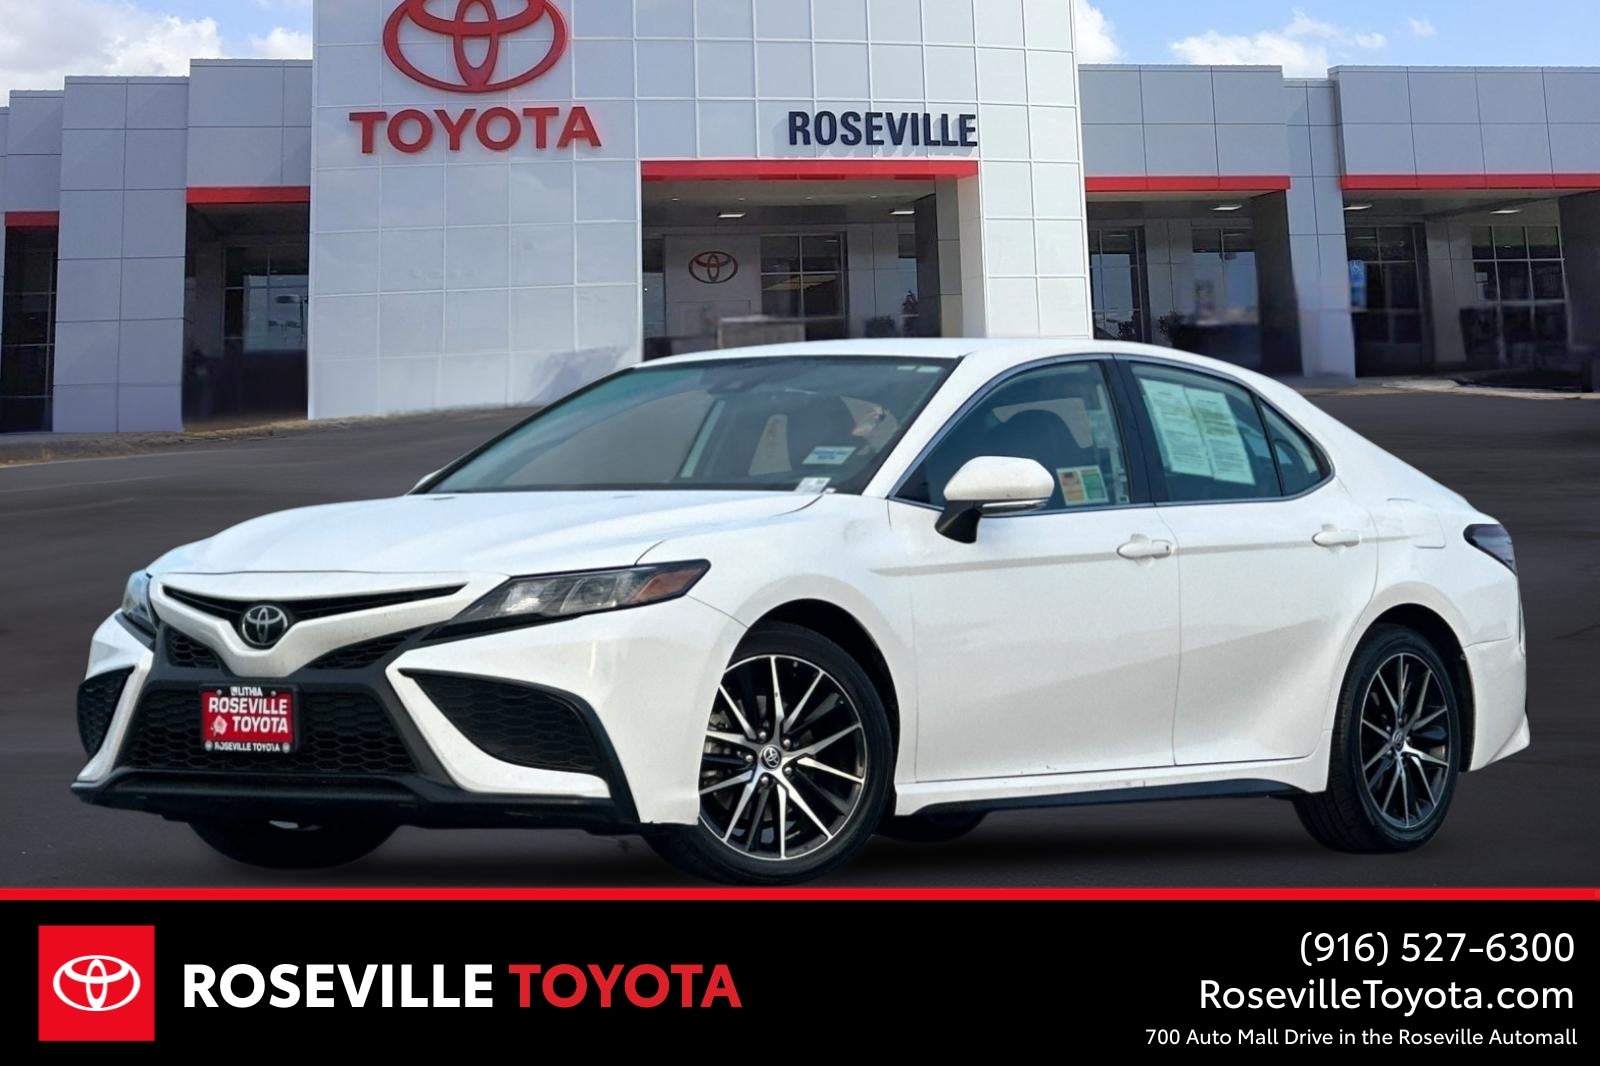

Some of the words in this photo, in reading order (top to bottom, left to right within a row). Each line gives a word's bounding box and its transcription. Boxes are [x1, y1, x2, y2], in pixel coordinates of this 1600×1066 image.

[349, 105, 602, 154] TOYOTA
[787, 110, 979, 148] ROSEVILLE
[238, 686, 263, 697] LITHIA
[208, 697, 288, 715] ROSEVILLE
[232, 716, 289, 733] TOYOTA
[214, 741, 252, 751] ROSEVILLE
[253, 742, 280, 752] TOYOTA
